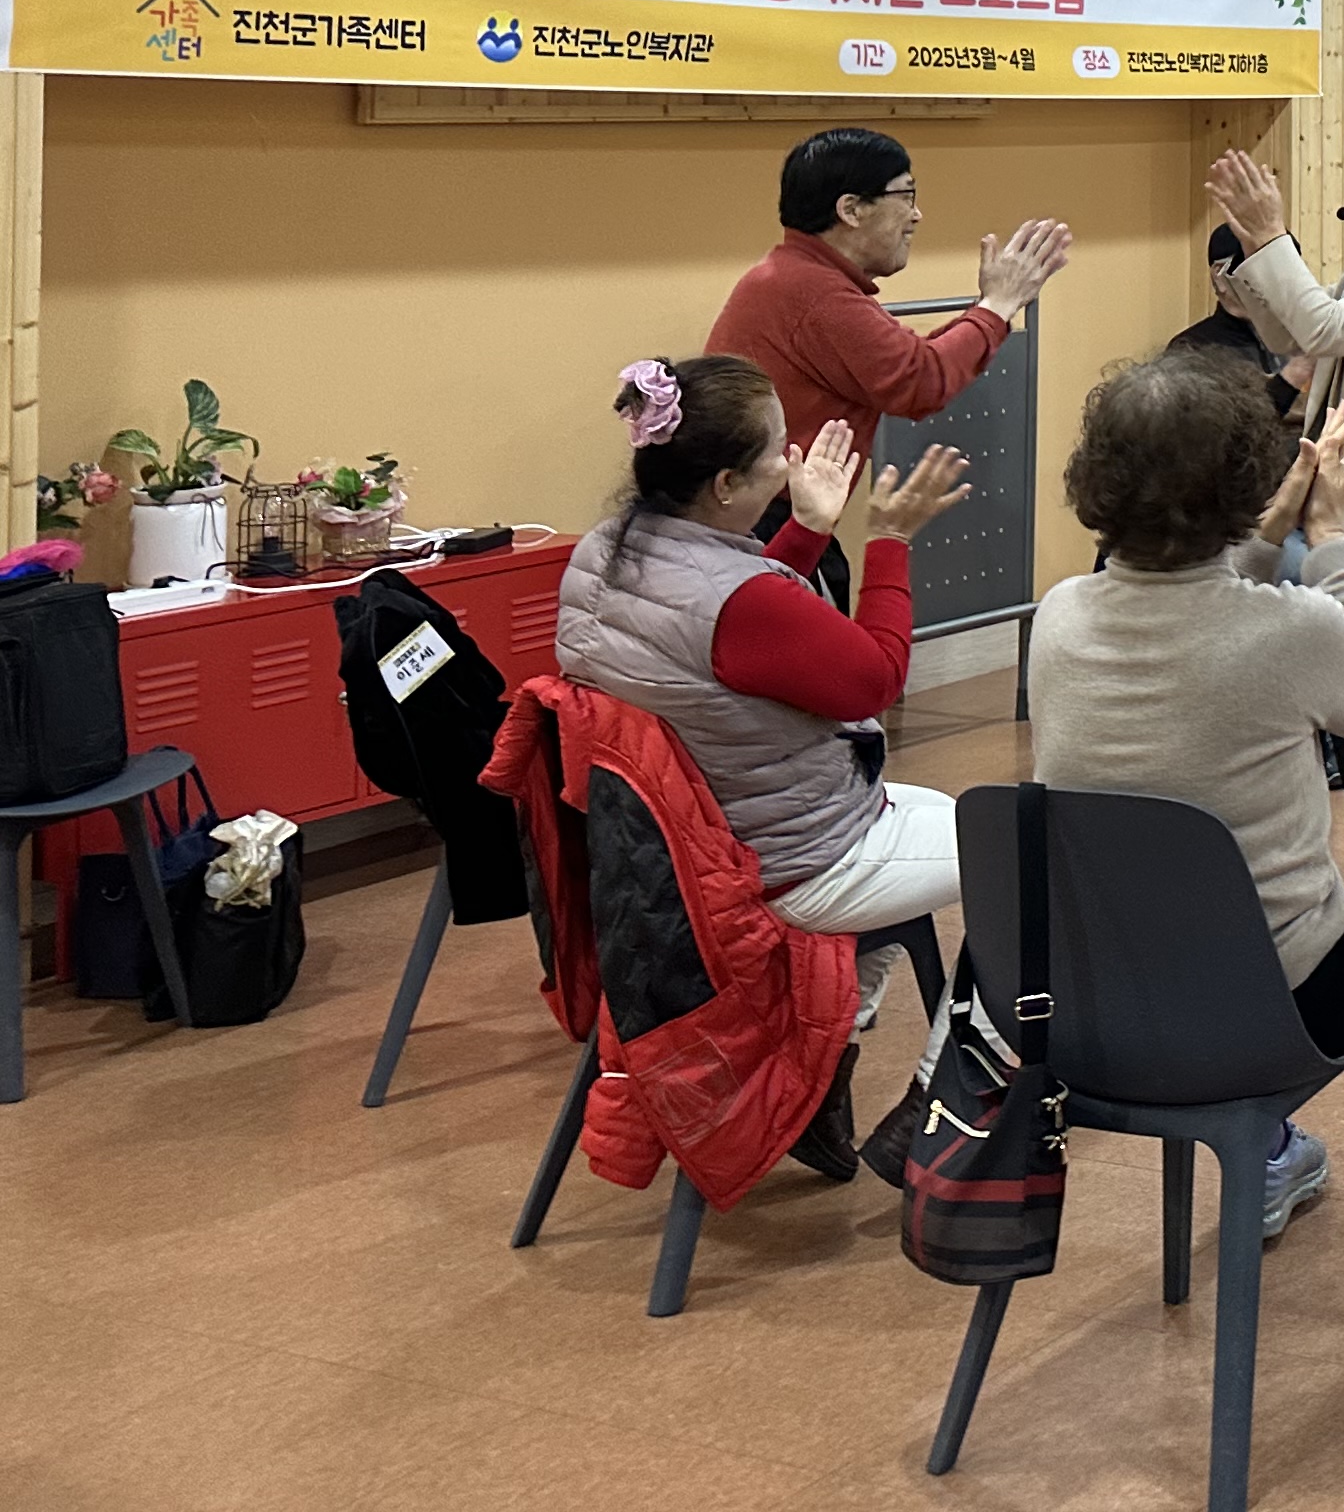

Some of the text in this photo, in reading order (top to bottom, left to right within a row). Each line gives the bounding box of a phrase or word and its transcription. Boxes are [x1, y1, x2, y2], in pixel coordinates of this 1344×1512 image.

[149, 0, 200, 38] 가족
[232, 9, 427, 52] 진천군가족센터
[145, 27, 202, 62] 센터
[532, 26, 715, 63] 진천군노인복지관
[851, 43, 1036, 72] 기간 2025년3월~4월
[1082, 49, 1269, 75] 장소 진천군노인복지관 지하1층
